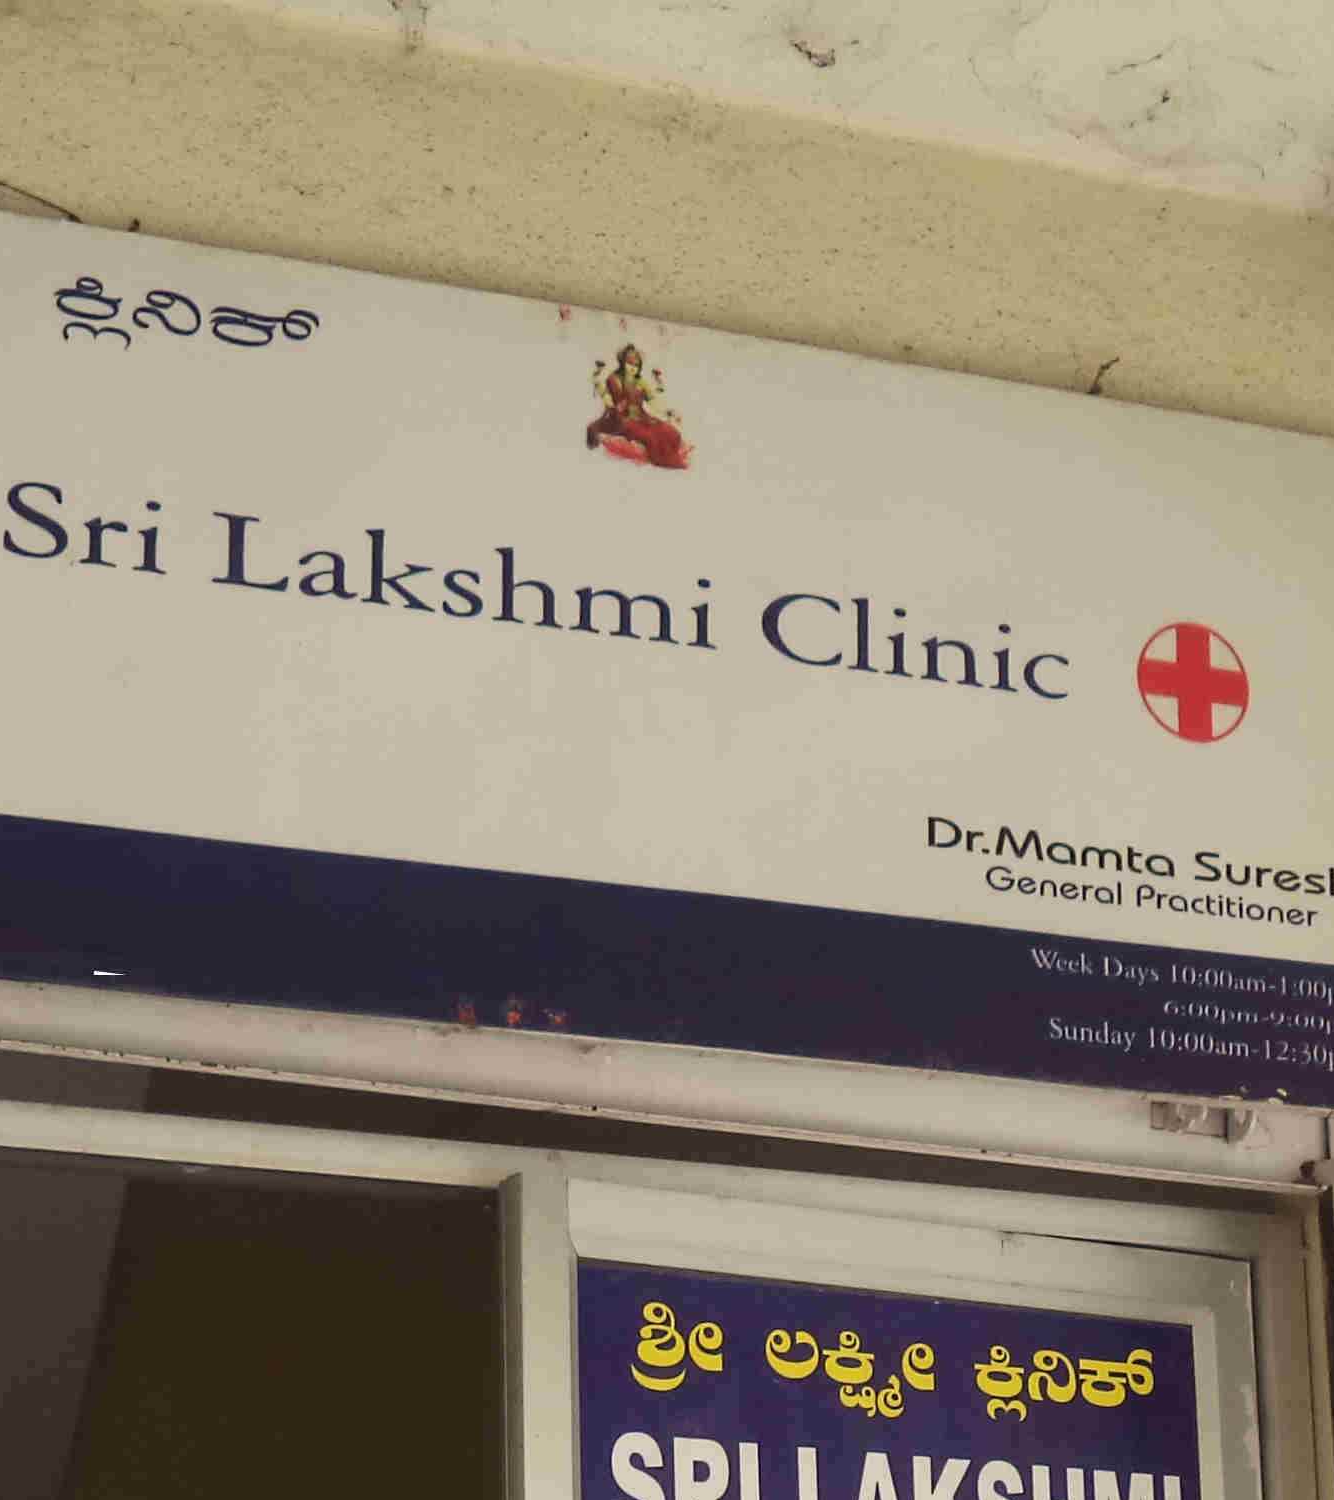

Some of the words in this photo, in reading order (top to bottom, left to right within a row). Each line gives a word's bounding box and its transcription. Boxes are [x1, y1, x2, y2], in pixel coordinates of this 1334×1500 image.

[54, 276, 320, 351] ಕ್ಲಿನಿಕ್
[2, 481, 167, 575] Sri
[210, 511, 718, 651] Lakshmi
[760, 592, 1069, 701] Clinic
[926, 816, 1175, 877] Dr.Mamta
[985, 866, 1123, 906] General
[1136, 883, 1319, 927] Practitioner
[1030, 948, 1093, 975] Week
[1103, 956, 1160, 986] Days
[1048, 1017, 1137, 1052] Sunday
[630, 1300, 724, 1392] ಶ್ರೀ
[764, 1328, 936, 1418] ಲಕ್ಷ್ಮೀ
[973, 1344, 1155, 1421] ಕ್ಲಿನಿಕ್
